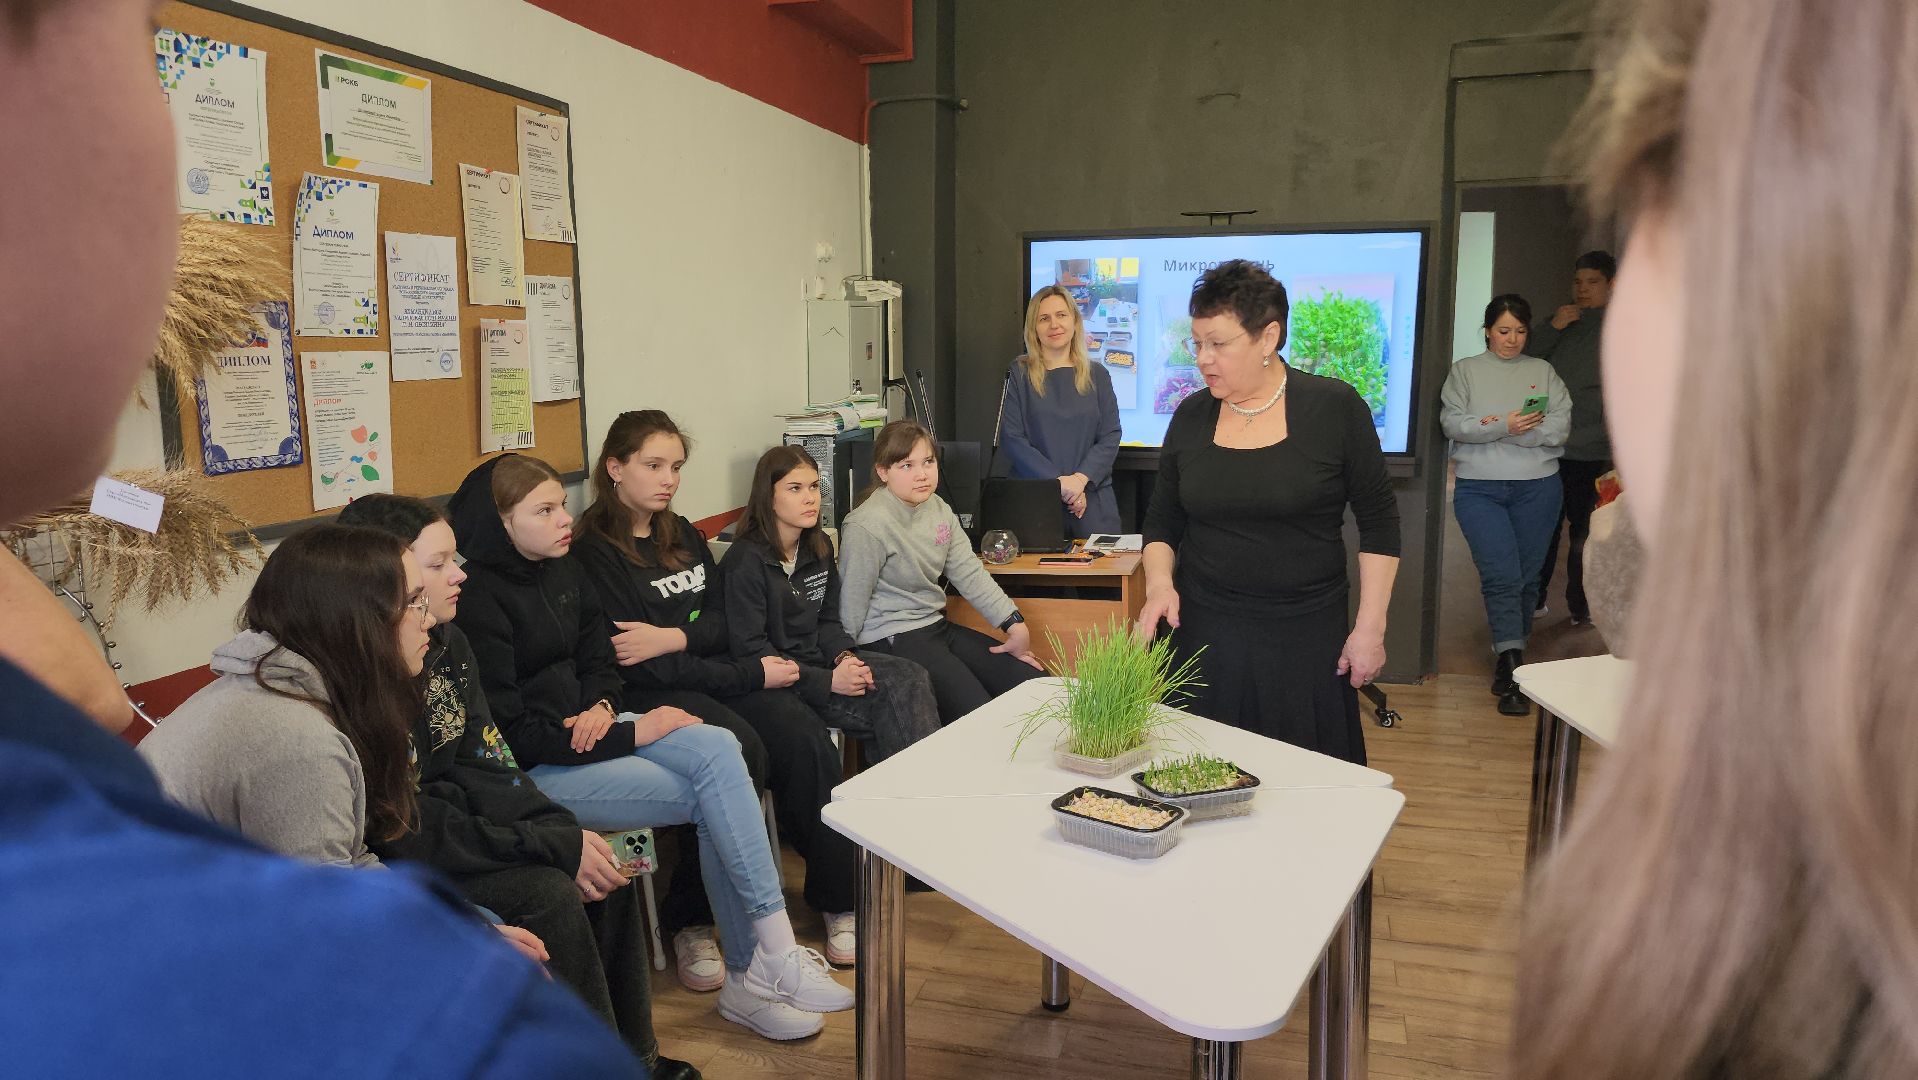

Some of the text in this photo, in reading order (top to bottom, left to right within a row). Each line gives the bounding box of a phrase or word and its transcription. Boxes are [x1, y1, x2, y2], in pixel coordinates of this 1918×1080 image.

[195, 93, 235, 109] ДИПЛОМ
[361, 93, 397, 109] ДИПЛОМ
[1164, 259, 1275, 274] Микронь
[393, 271, 451, 284] СЕРТИФИКАТ
[217, 355, 272, 368] ДИПЛОМ
[650, 563, 706, 599] TODA
